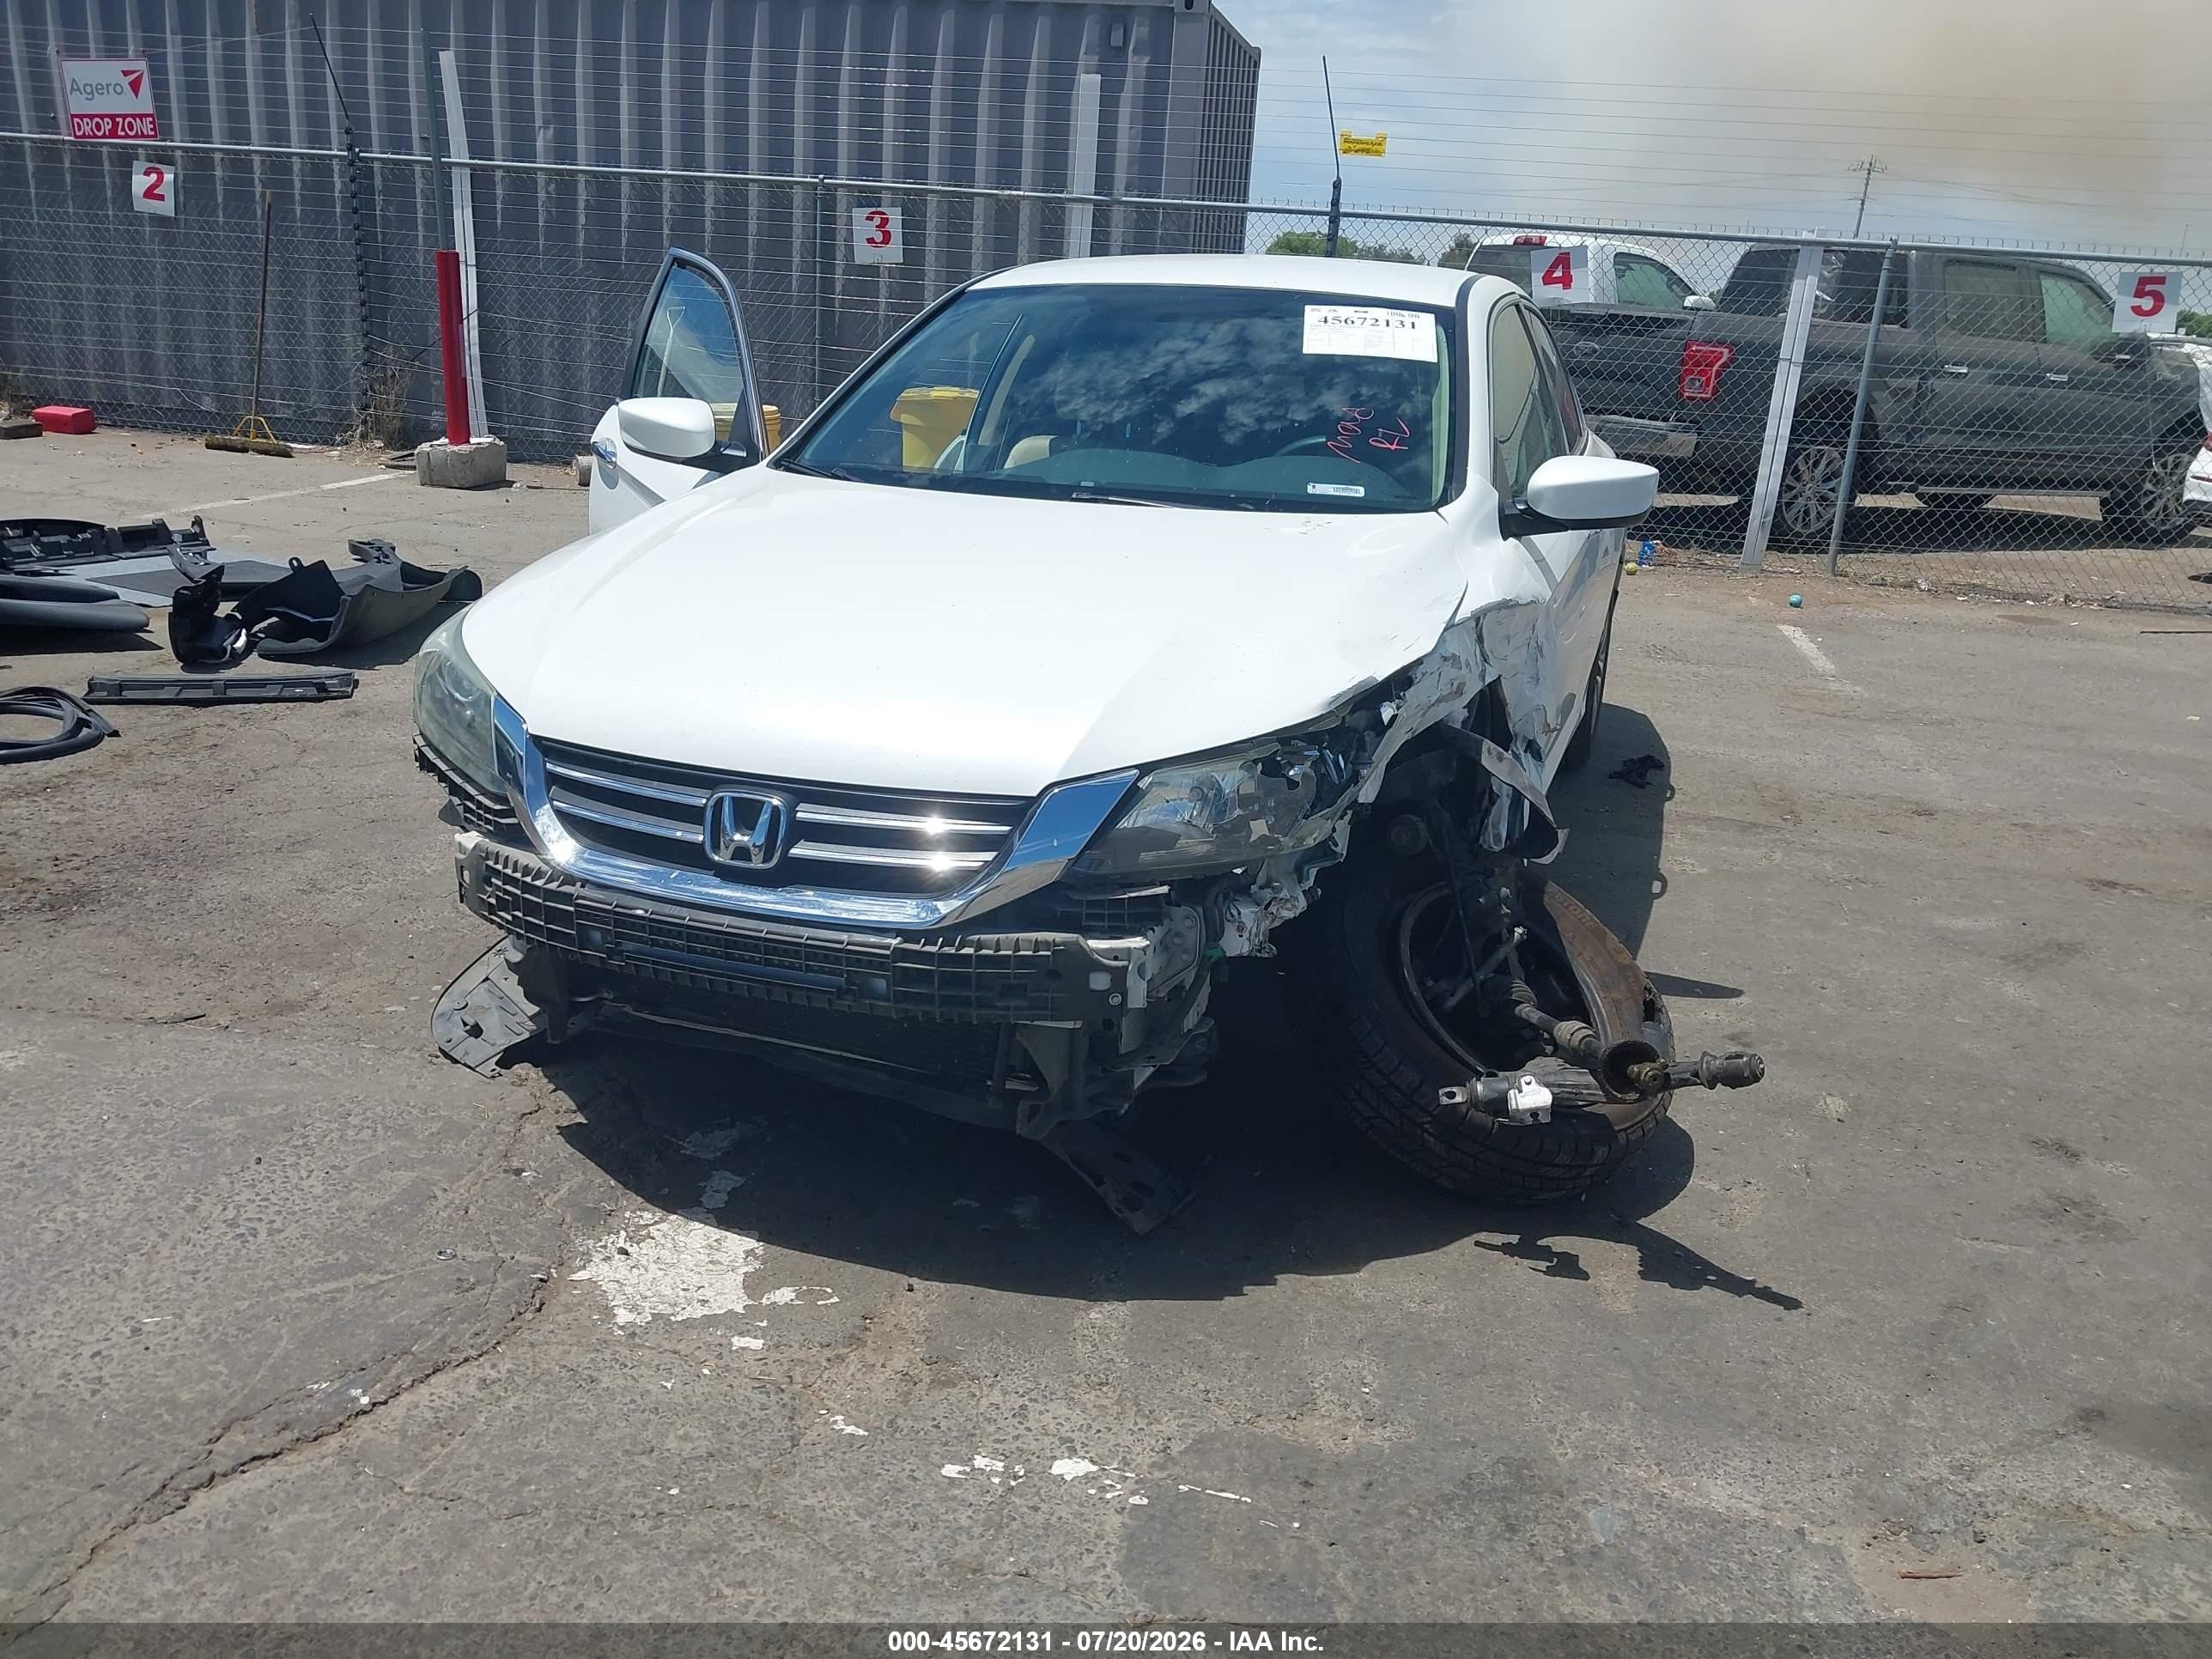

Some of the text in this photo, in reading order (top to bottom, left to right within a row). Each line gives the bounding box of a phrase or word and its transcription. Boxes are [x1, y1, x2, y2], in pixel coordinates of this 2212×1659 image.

[70, 77, 124, 101] Agero
[73, 116, 155, 137] DROP ZONE
[143, 166, 166, 202] 2
[865, 210, 892, 249] 3
[1540, 251, 1574, 290] 4
[2130, 276, 2167, 318] 5
[1317, 314, 1418, 330] 45672131
